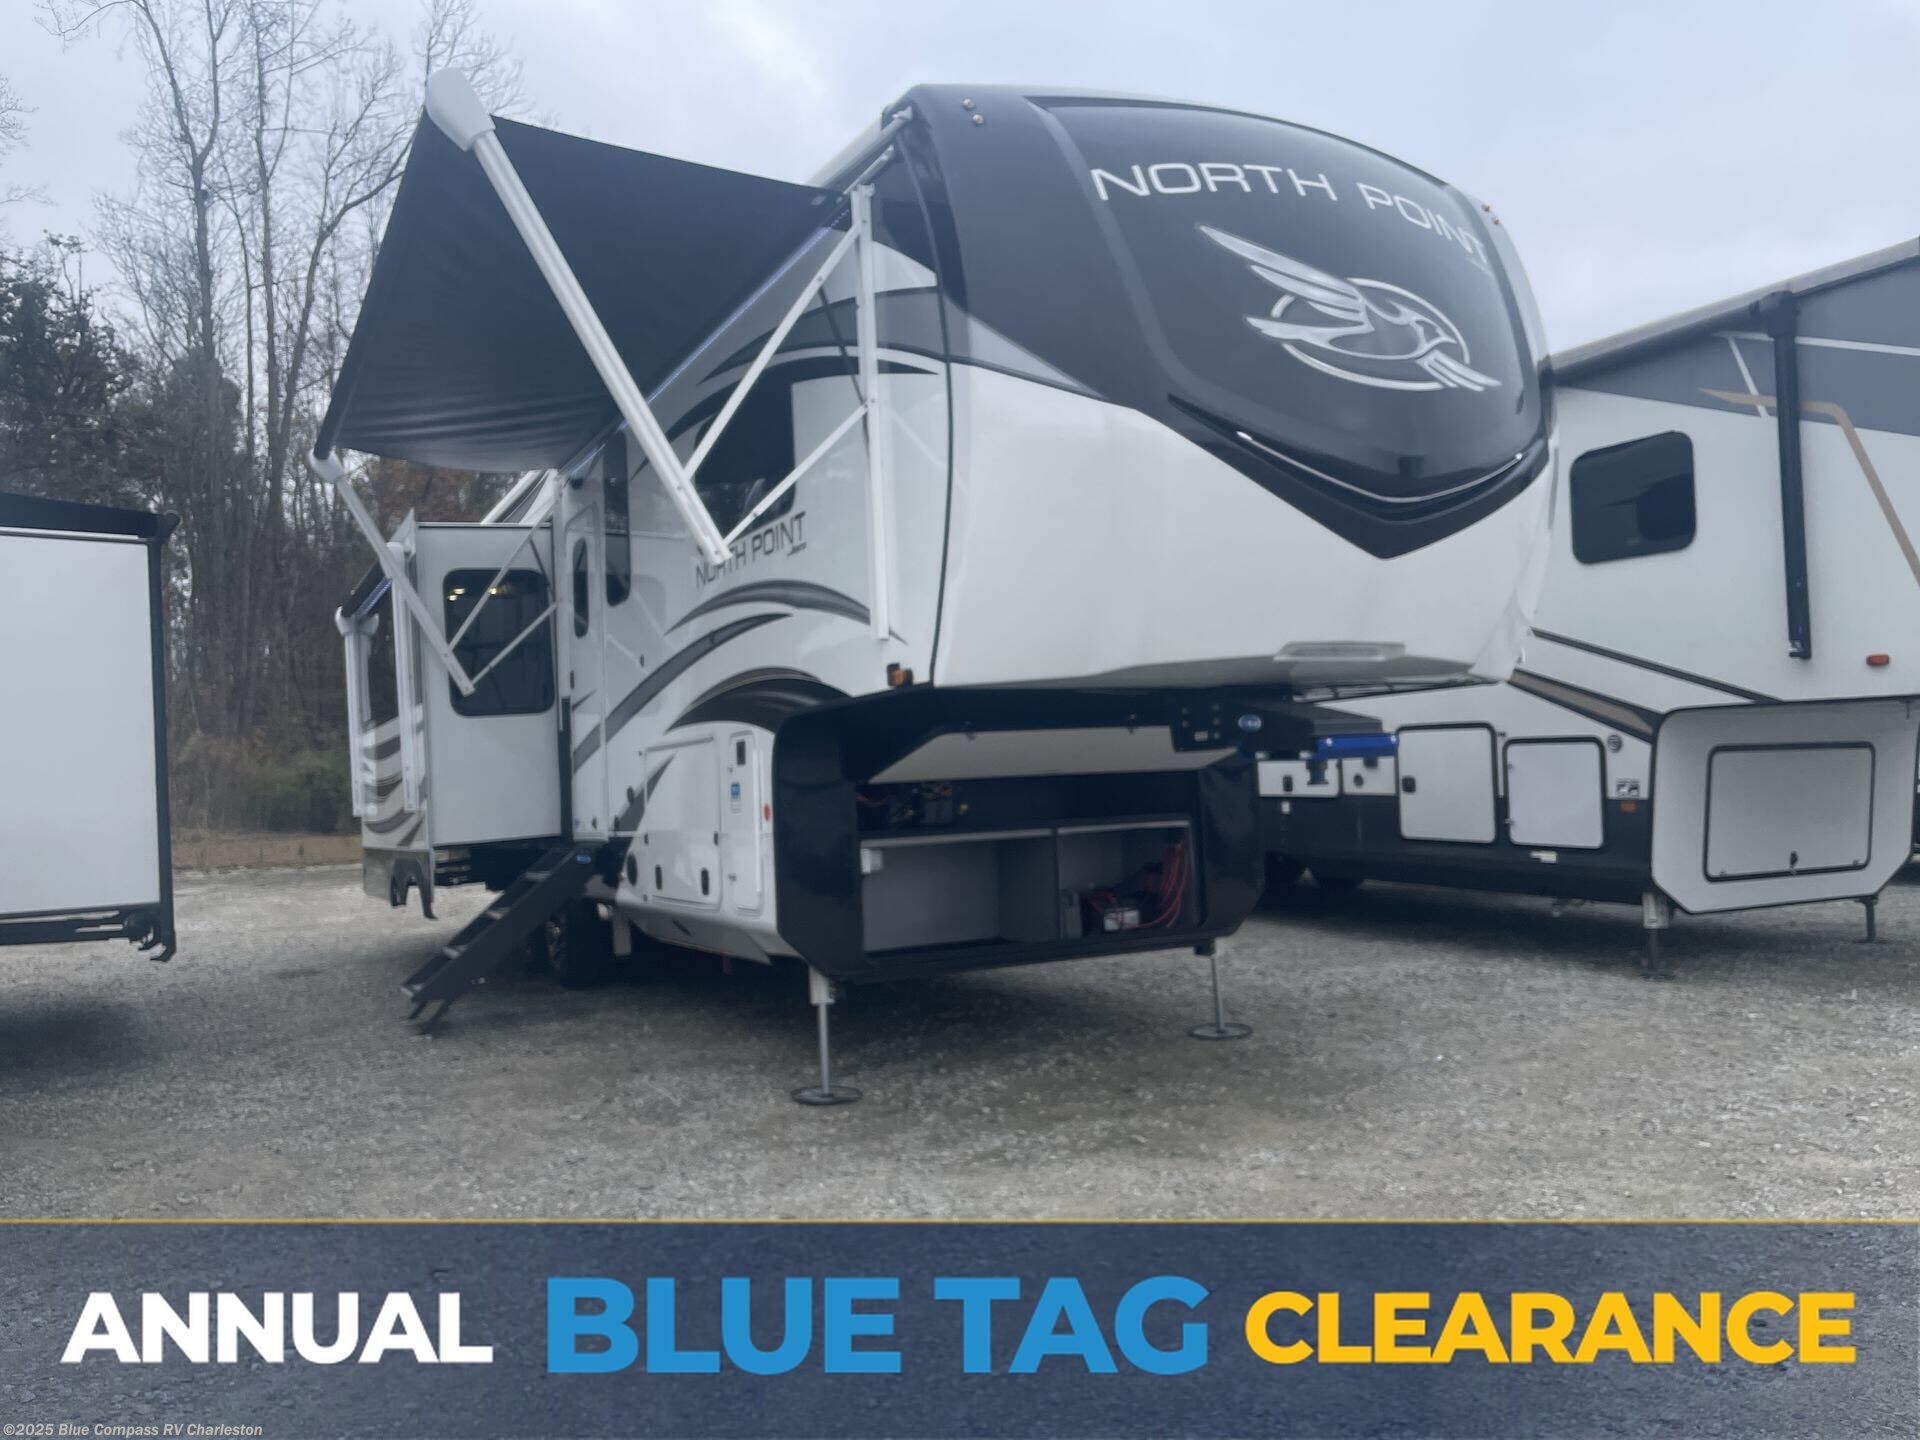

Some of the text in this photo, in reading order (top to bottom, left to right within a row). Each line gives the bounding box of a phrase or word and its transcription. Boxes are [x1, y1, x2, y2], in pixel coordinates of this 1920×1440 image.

[1089, 161, 1488, 264] NORTH POINT
[751, 510, 807, 562] POINT
